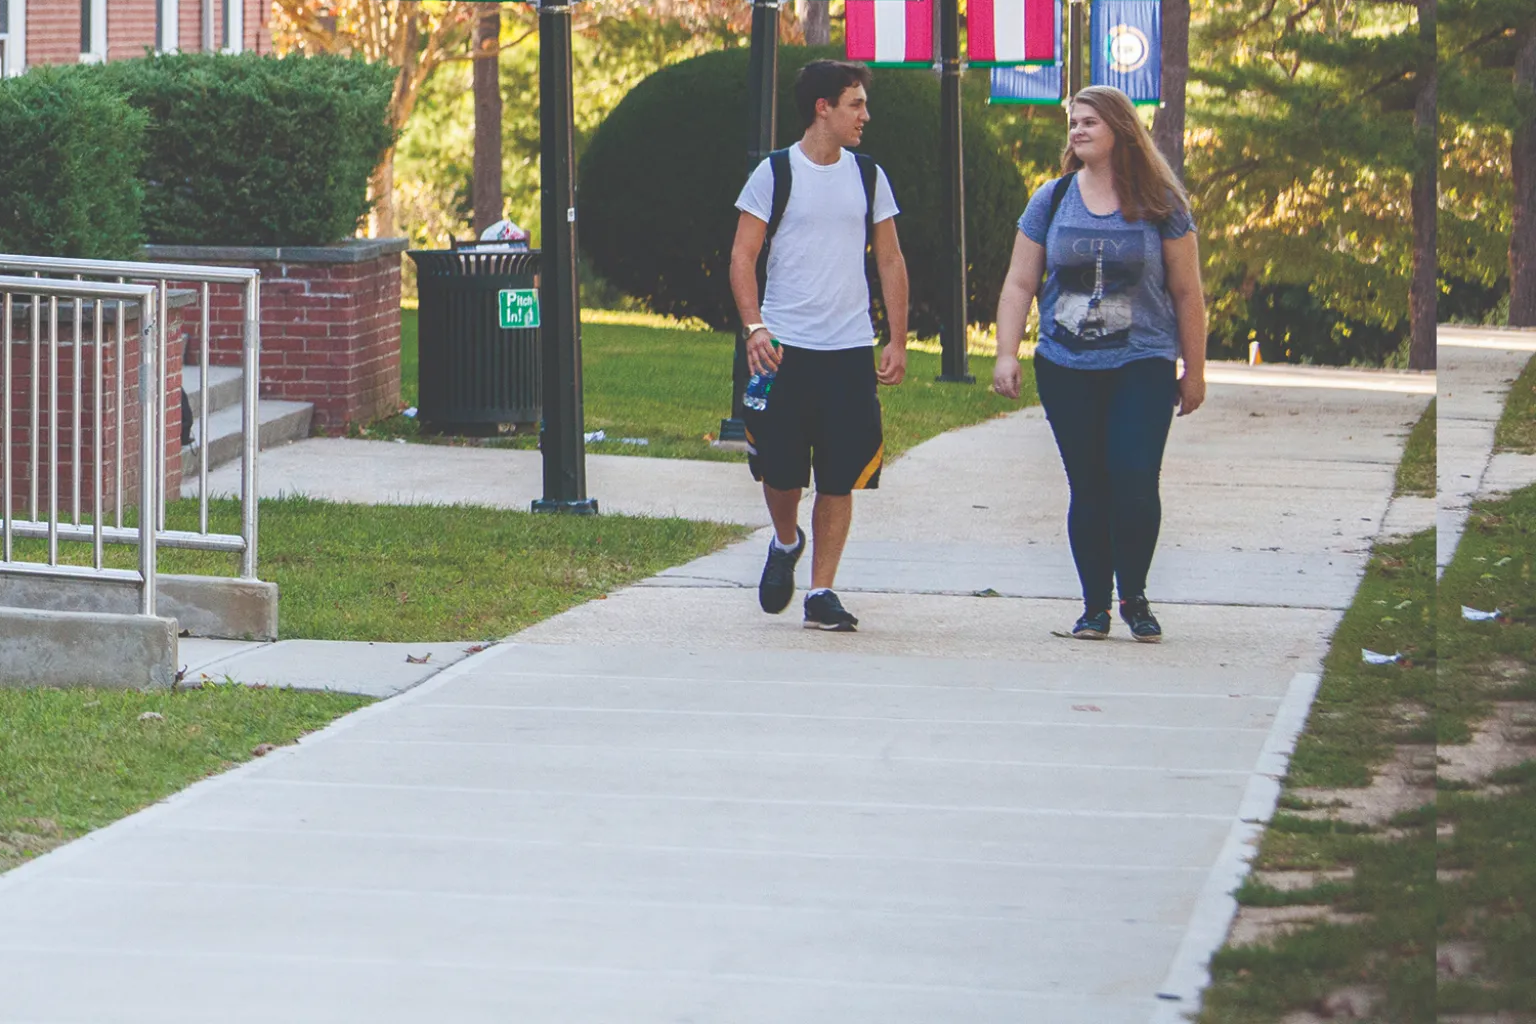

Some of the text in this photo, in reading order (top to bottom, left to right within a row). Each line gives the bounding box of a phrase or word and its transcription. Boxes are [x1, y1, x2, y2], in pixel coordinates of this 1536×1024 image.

[1073, 237, 1125, 257] CITY
[507, 291, 533, 307] Pitch
[507, 307, 522, 323] In!
